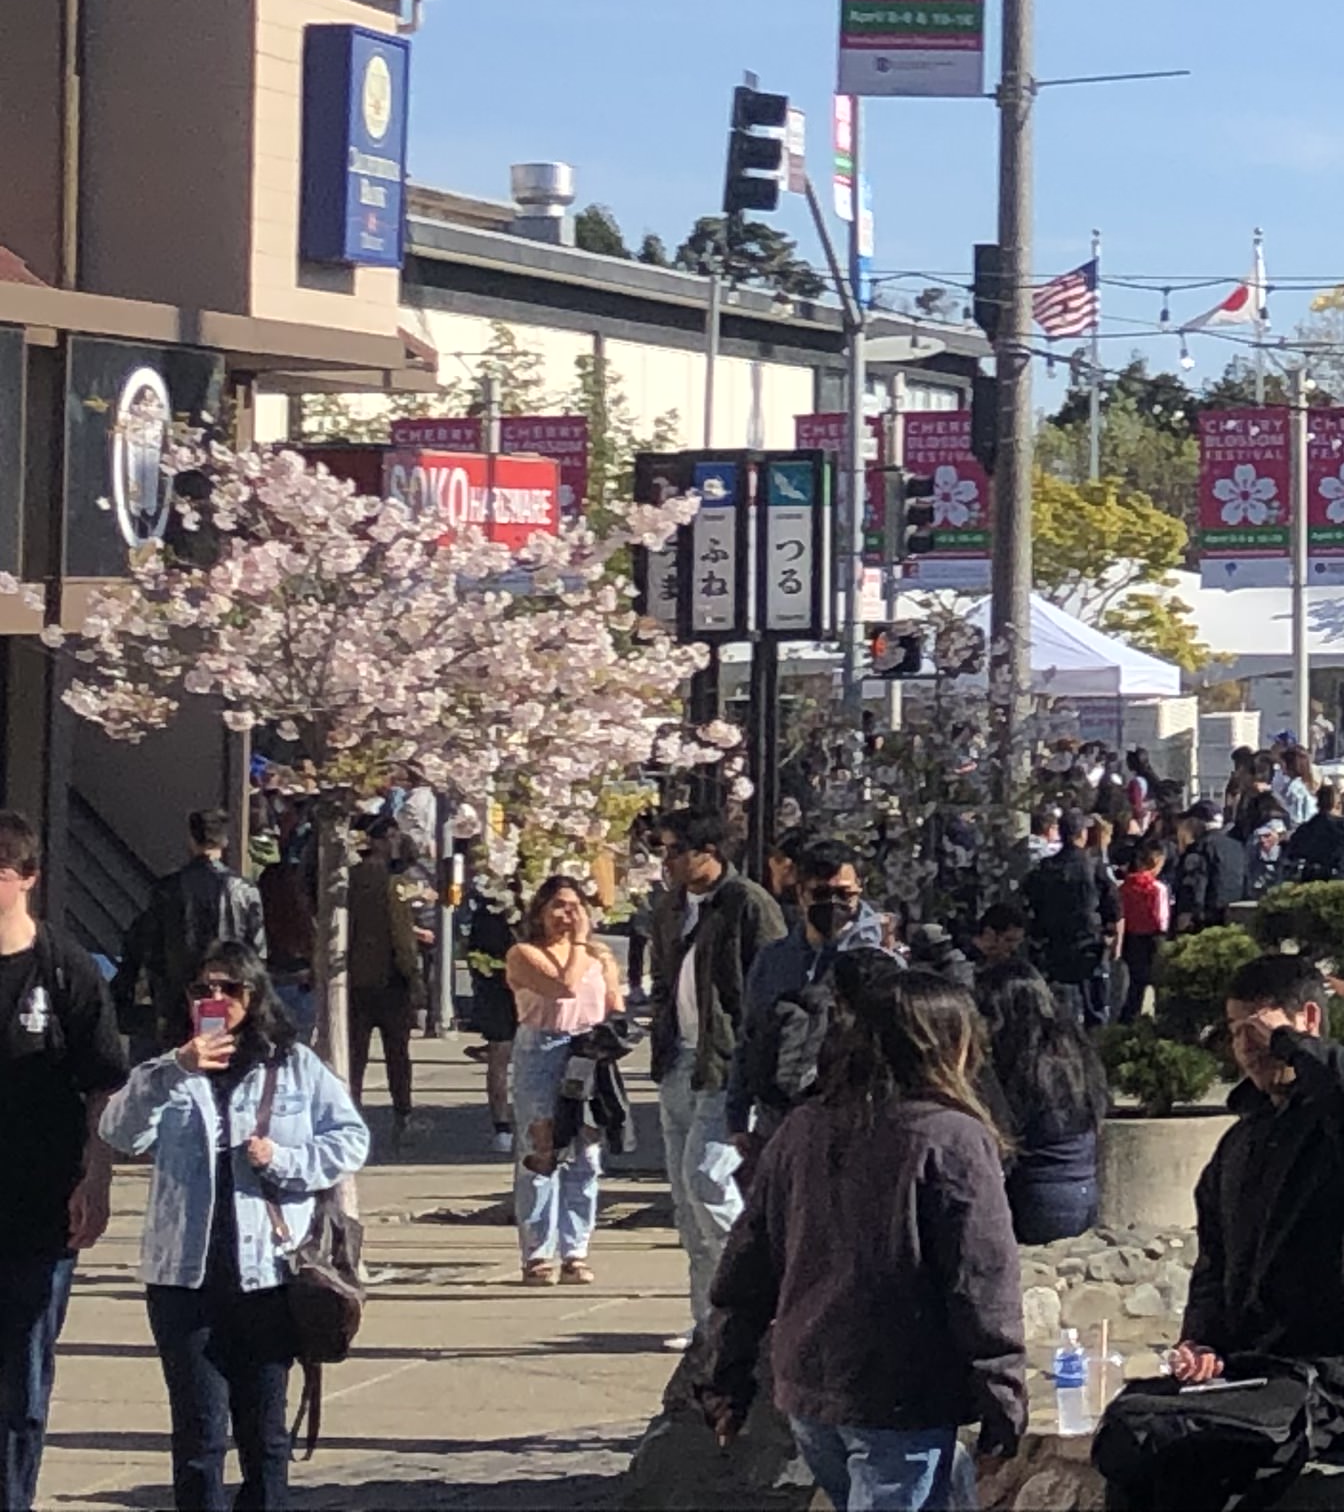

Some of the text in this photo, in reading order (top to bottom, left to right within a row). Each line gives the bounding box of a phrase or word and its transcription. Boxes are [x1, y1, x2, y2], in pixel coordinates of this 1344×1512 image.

[504, 425, 582, 440] CHERRY
[907, 420, 971, 435] CHERR
[394, 428, 474, 443] CHERRY
[906, 436, 972, 450] BLOSSO
[1205, 433, 1285, 448] BLOSSOM
[906, 450, 977, 464] FESTIVA
[1206, 449, 1284, 462] FESTIVAL
[390, 464, 469, 526] SOKO
[700, 537, 729, 597] ふね
[775, 539, 805, 595] つる
